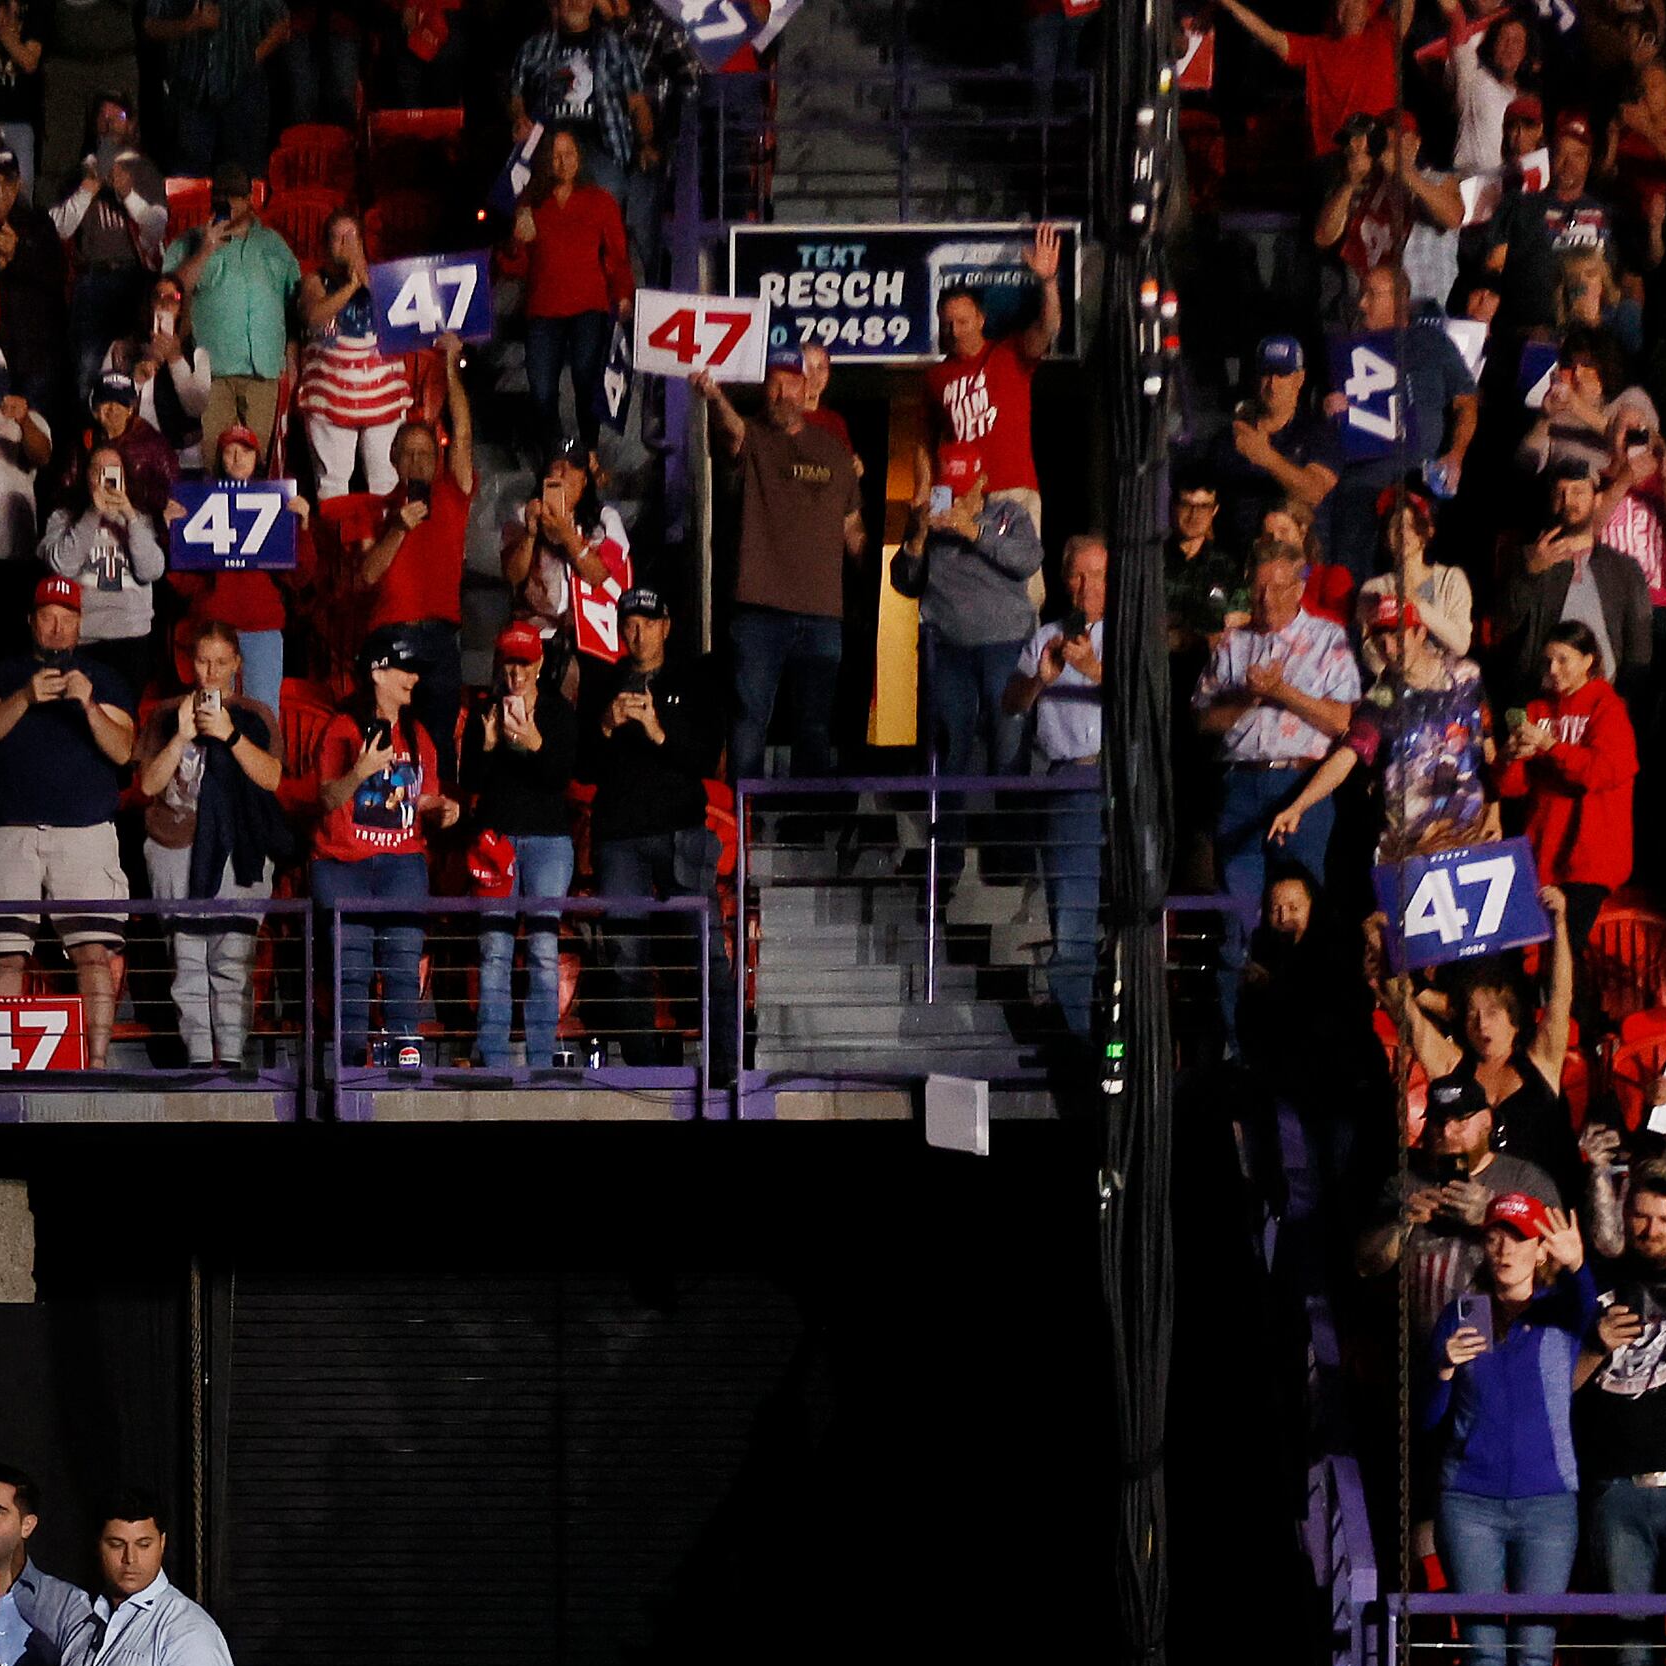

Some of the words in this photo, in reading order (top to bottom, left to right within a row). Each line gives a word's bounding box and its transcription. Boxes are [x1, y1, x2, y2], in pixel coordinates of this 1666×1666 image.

[798, 243, 867, 269] TEXT
[387, 263, 478, 334] 47
[758, 270, 906, 308] RESCH
[648, 309, 752, 366] 47
[796, 315, 911, 347] 79489
[1344, 346, 1399, 442] 47
[183, 491, 282, 557] 47
[1404, 855, 1516, 945] 47
